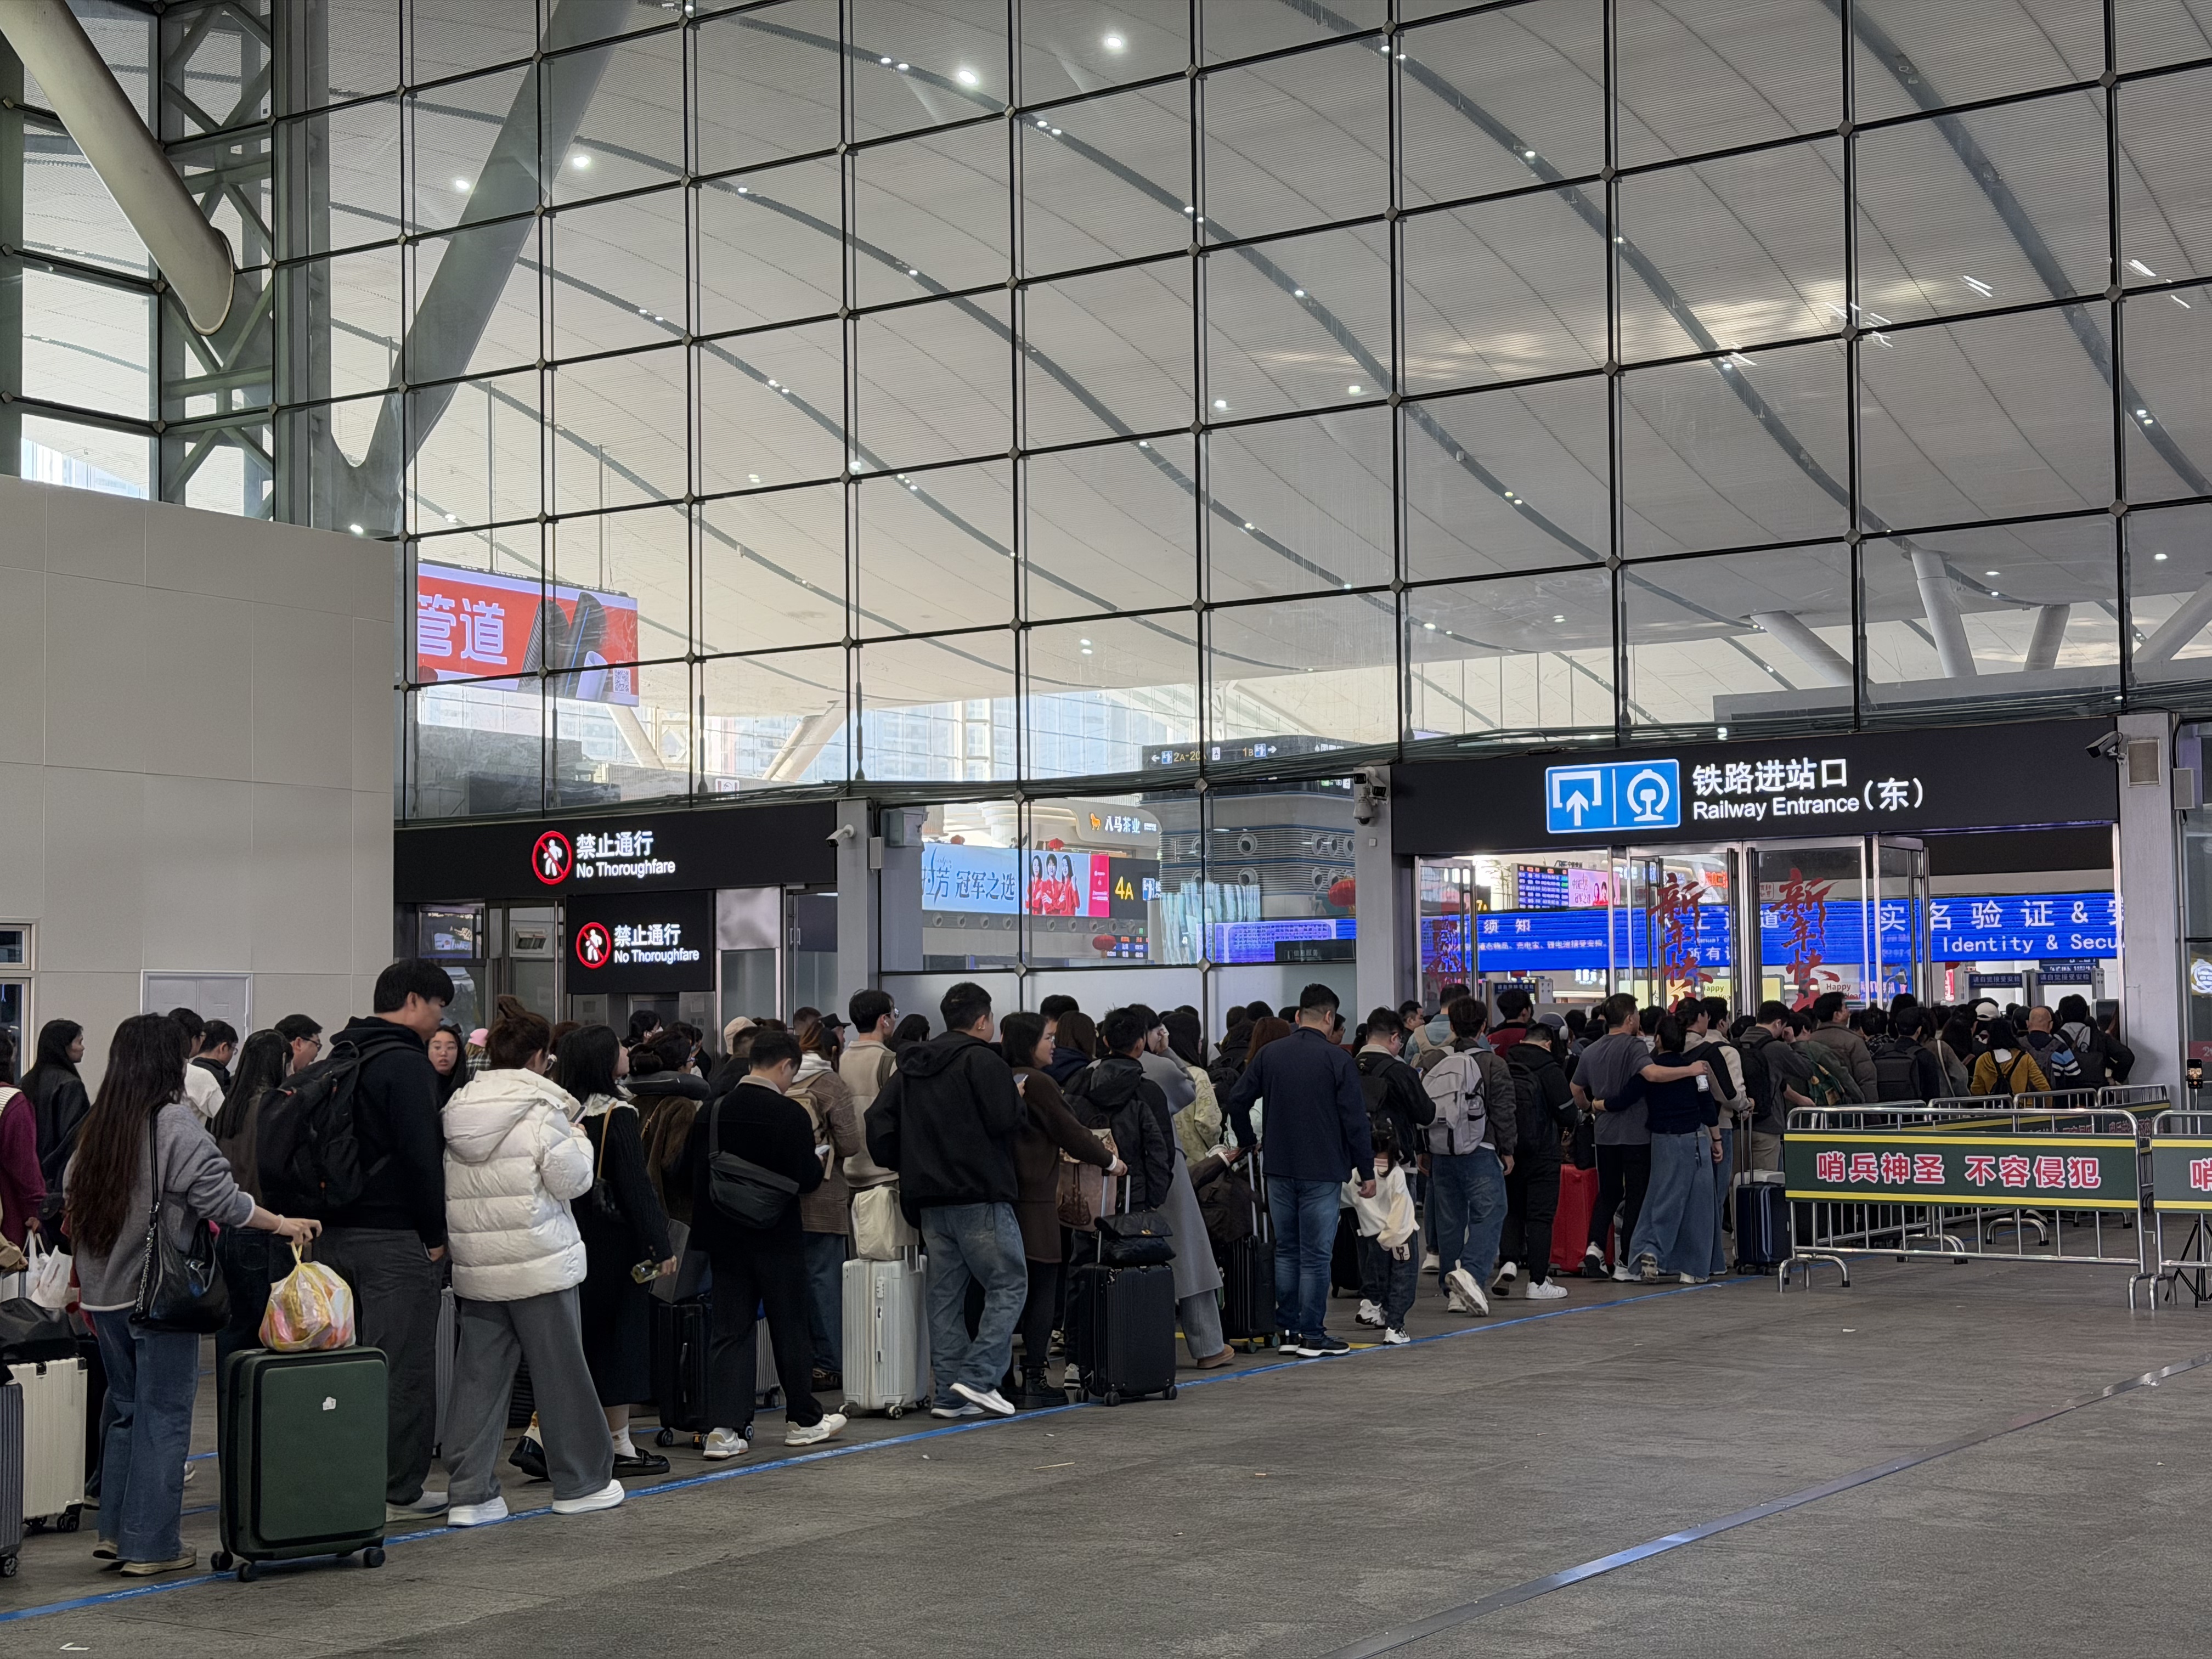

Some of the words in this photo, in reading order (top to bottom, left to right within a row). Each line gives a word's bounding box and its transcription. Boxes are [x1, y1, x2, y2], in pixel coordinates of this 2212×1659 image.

[417, 594, 507, 665] 管道
[1243, 747, 1254, 757] 1B
[1692, 757, 1847, 796] 铁路进站口
[1693, 800, 1767, 821] Railway
[1773, 796, 1860, 816] Entrance
[1104, 815, 1141, 833] 八马茶业
[576, 831, 653, 860] 禁止通行
[576, 863, 594, 878] No
[596, 859, 676, 878] Thoroughfare
[955, 870, 1015, 901] 冠军之选
[1115, 876, 1134, 900] 4A
[2071, 901, 2089, 923] &
[614, 924, 681, 947] 禁止通行
[1943, 936, 2034, 953] Identity
[2046, 934, 2058, 950] &
[614, 949, 629, 963] No
[631, 948, 699, 964] Thoroughfare
[1826, 983, 1851, 991] Happy
[1816, 1150, 1945, 1185] 哨兵神圣
[1964, 1154, 2102, 1189] 不容侵犯
